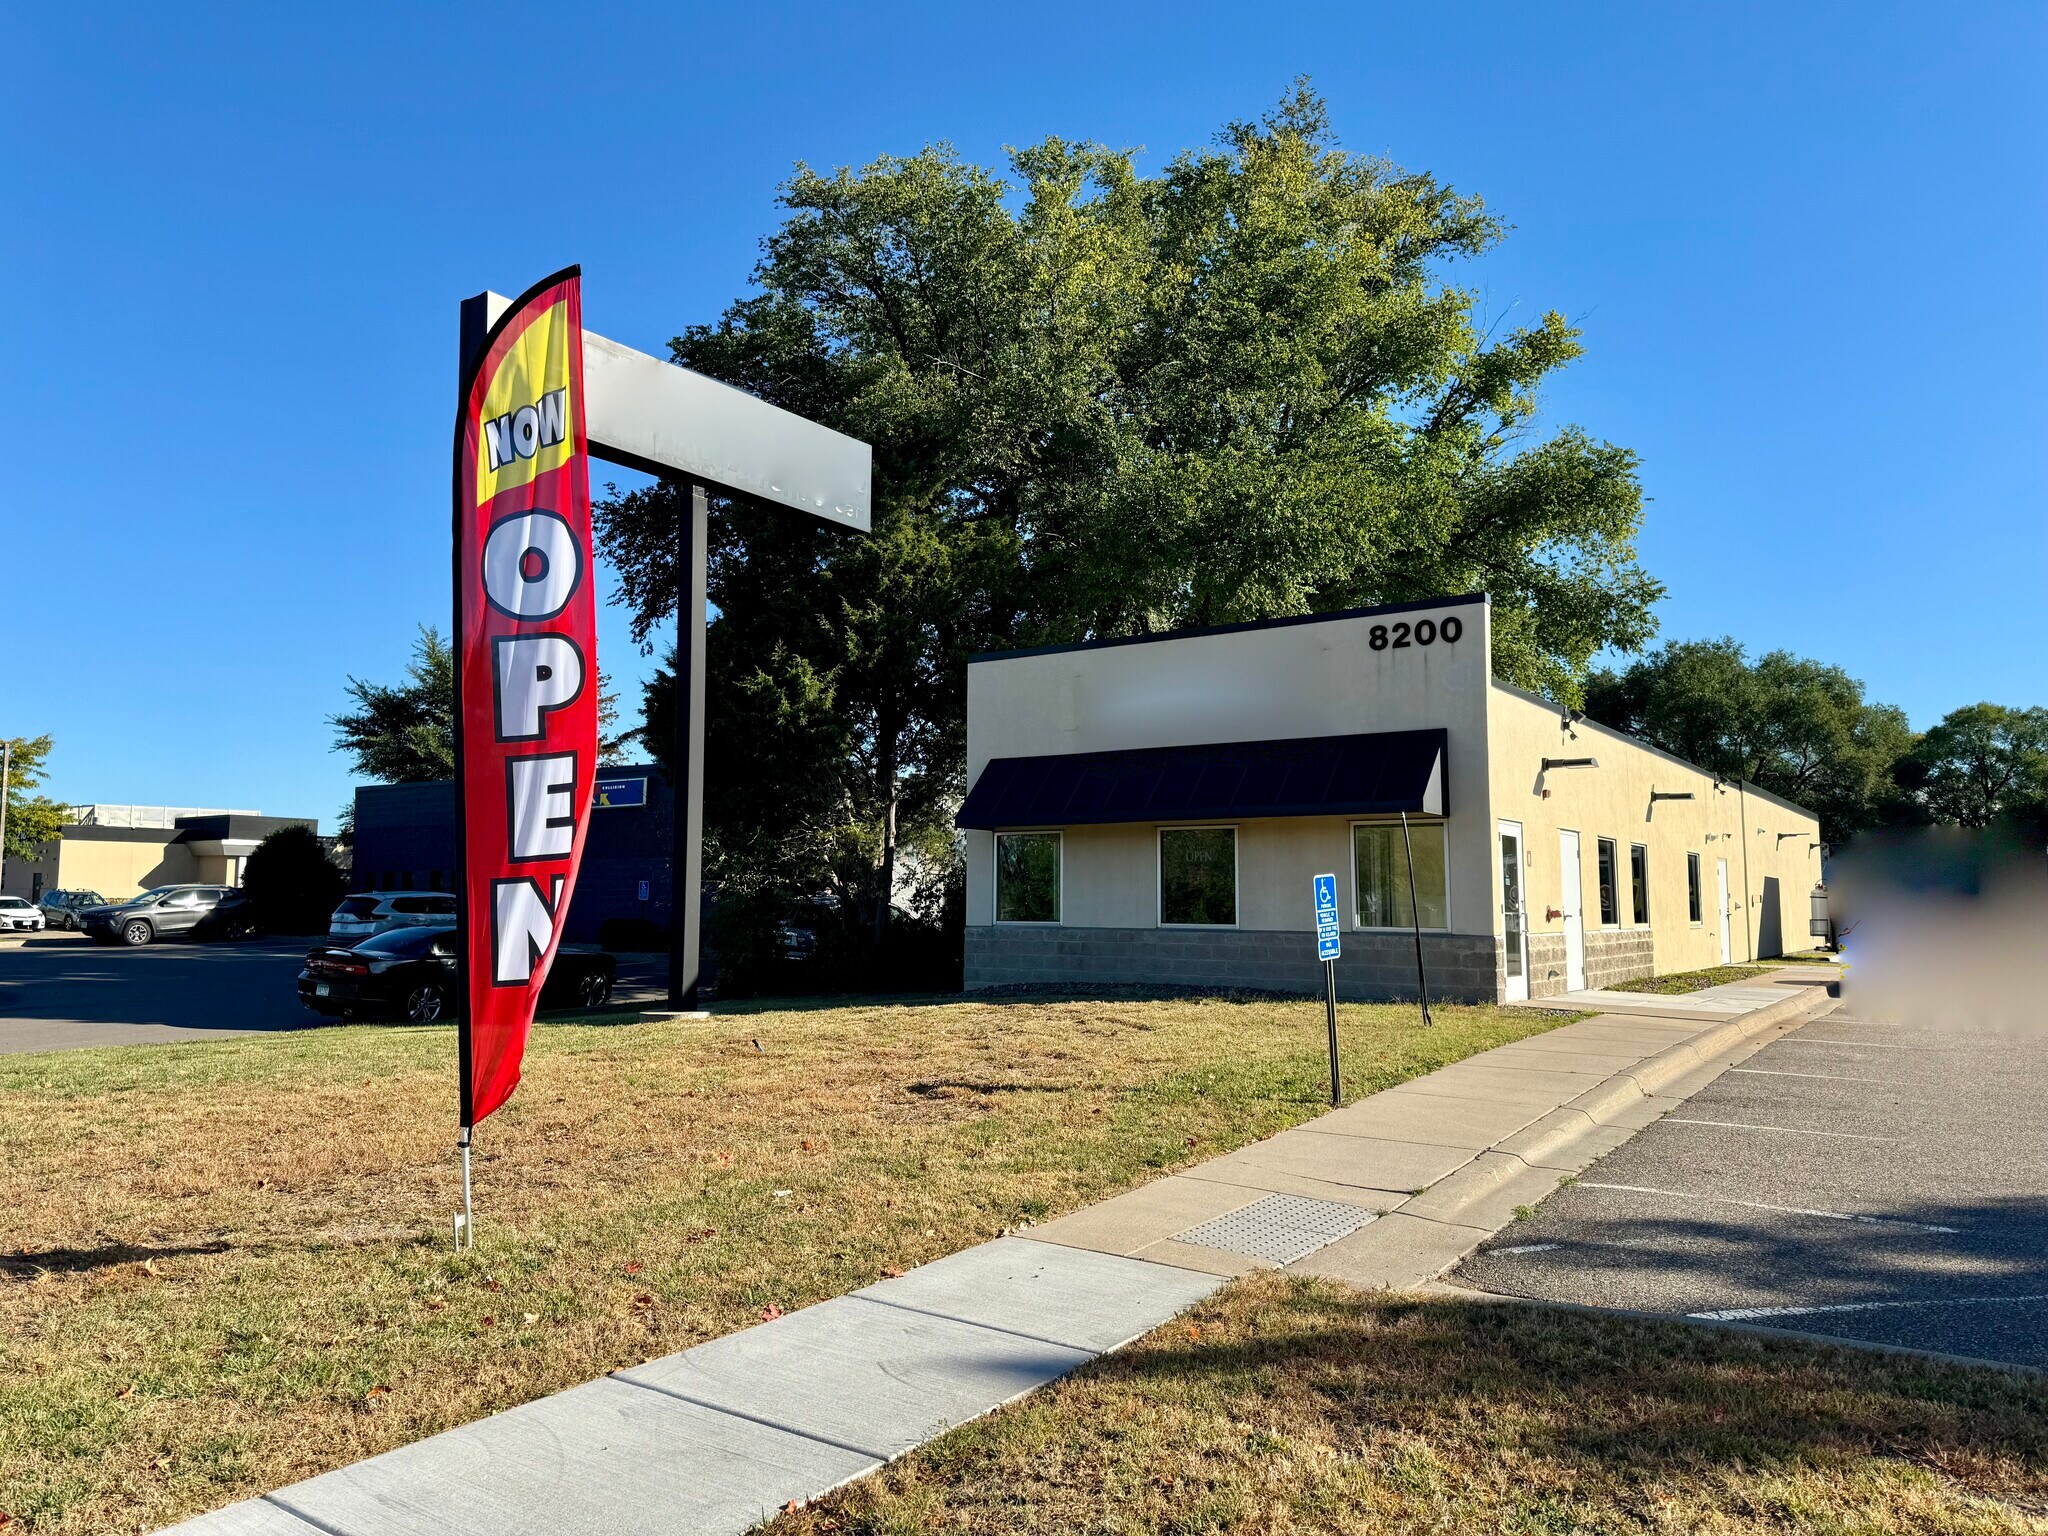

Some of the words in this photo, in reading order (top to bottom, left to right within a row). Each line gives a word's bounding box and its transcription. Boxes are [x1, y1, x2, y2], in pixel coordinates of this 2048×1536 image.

[485, 386, 566, 473] NOW
[1369, 616, 1463, 651] 8200
[481, 508, 584, 987] OPEN
